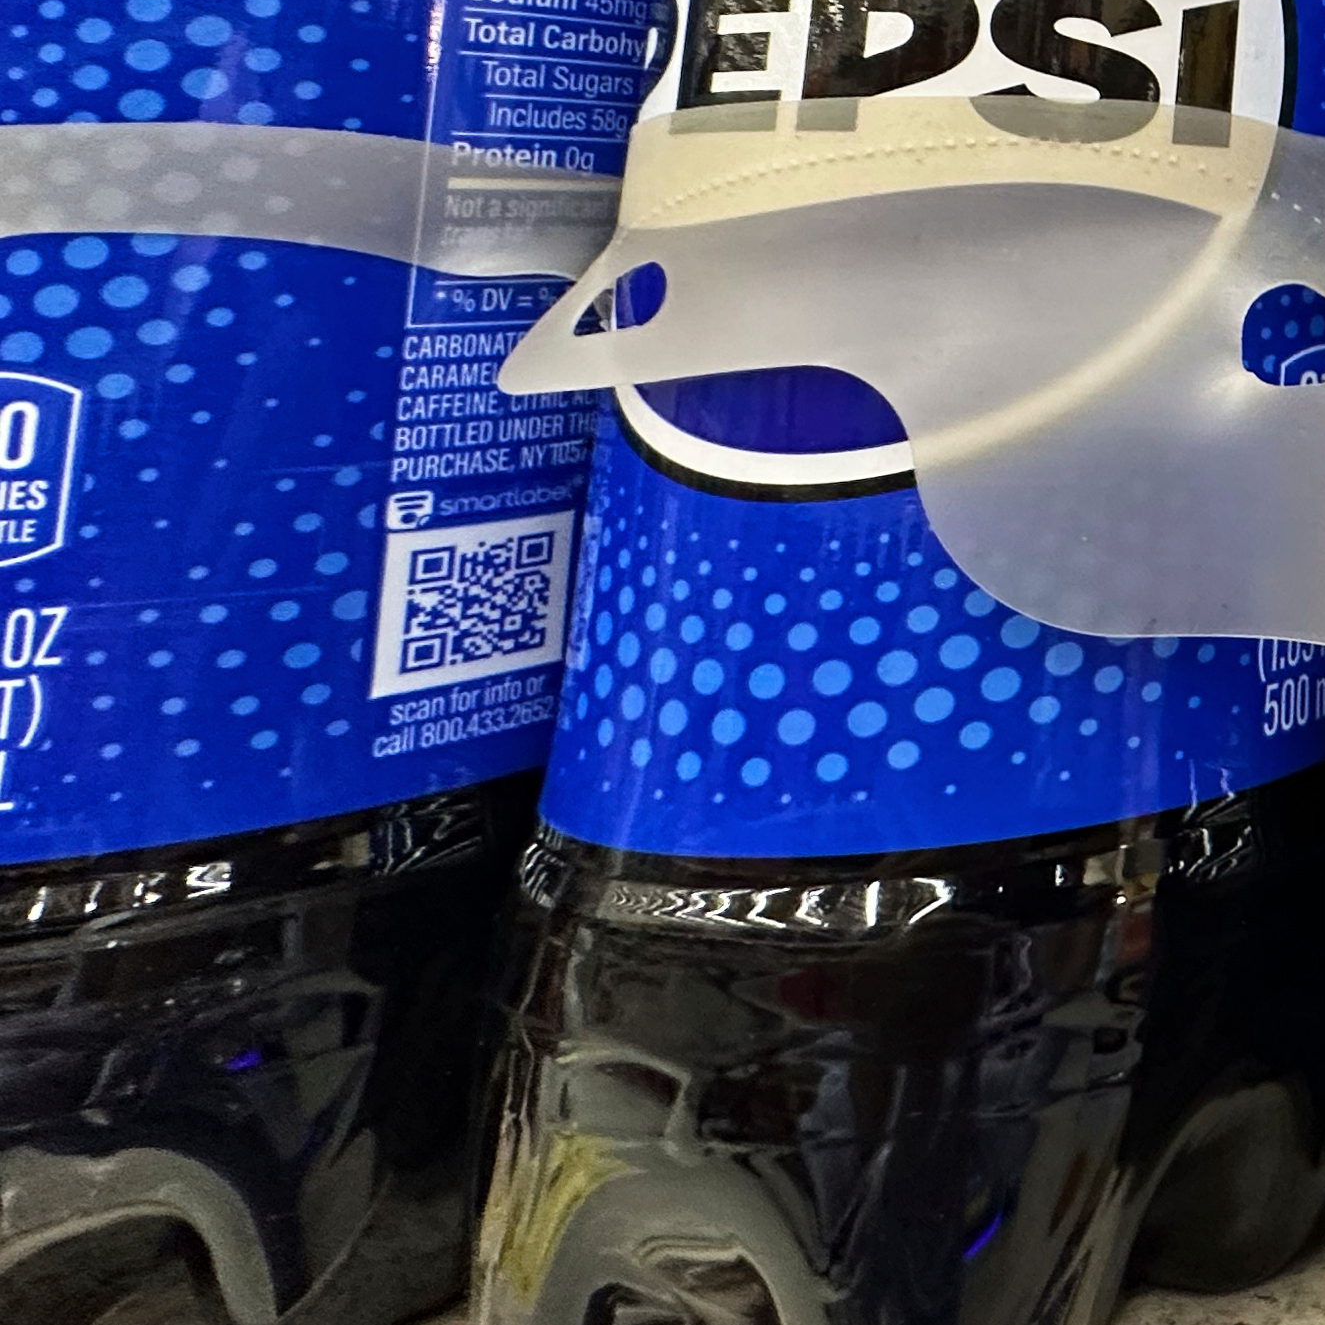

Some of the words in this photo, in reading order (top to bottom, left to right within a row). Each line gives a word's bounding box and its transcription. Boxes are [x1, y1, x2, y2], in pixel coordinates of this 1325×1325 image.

[464, 17, 535, 49] Total
[482, 60, 548, 90] Total
[554, 65, 635, 98] Sugars
[489, 100, 586, 131] Includes
[591, 110, 629, 139] 58g
[452, 142, 556, 169] Protein
[564, 148, 595, 172] 0g
[443, 195, 485, 218] Not
[482, 287, 515, 312] DV
[395, 418, 494, 453] BOTTLED
[498, 415, 565, 443] UNDER
[391, 448, 517, 482] PURCHASE,
[518, 444, 549, 470] NY
[2, 606, 69, 669] OZ
[388, 696, 445, 726] scan
[449, 687, 478, 714] for
[483, 678, 522, 708] info
[525, 674, 547, 695] or
[1263, 672, 1310, 737] 500
[372, 726, 414, 760] call
[420, 695, 553, 751] 800.433.2652
